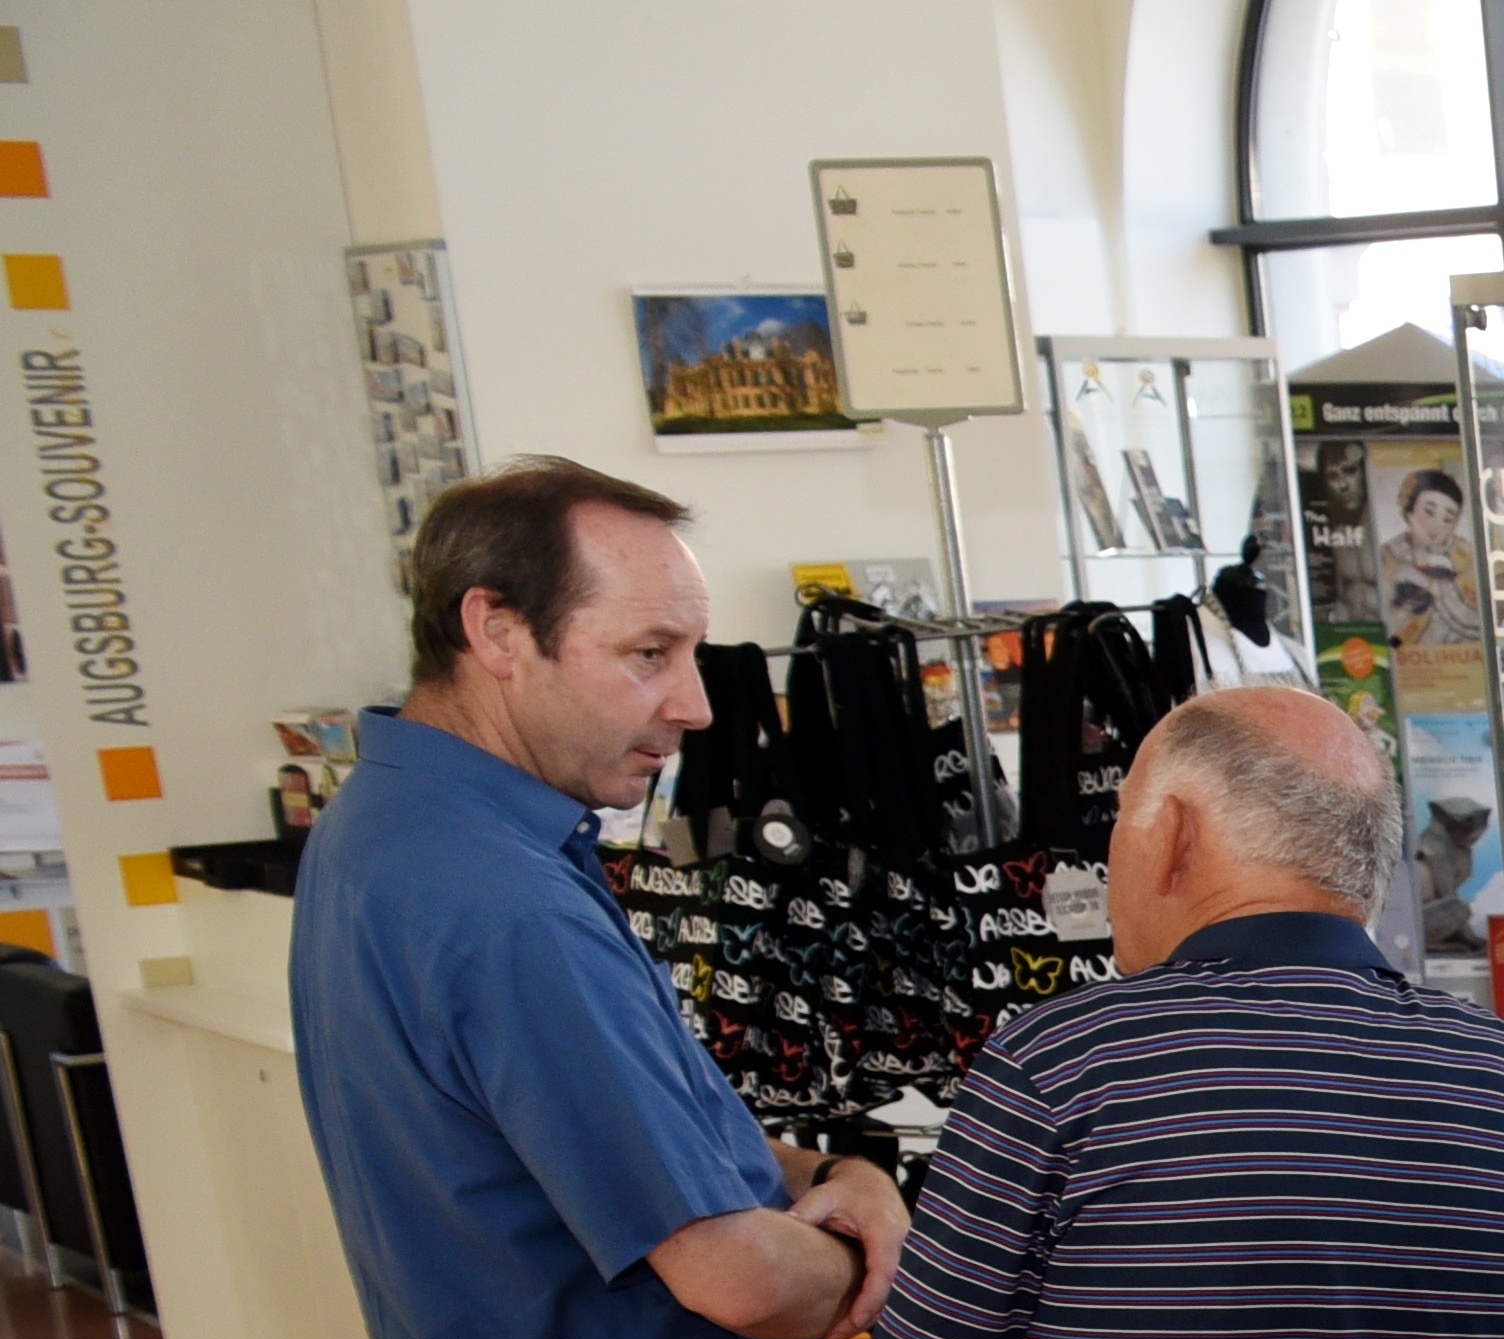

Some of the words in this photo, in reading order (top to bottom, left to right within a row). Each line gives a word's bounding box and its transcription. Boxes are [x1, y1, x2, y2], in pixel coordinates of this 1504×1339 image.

[1322, 402, 1361, 422] Ganz
[1364, 403, 1450, 424] entspannt
[20, 348, 150, 727] AUGSBURG-SOUVENIR
[1313, 526, 1363, 547] Half
